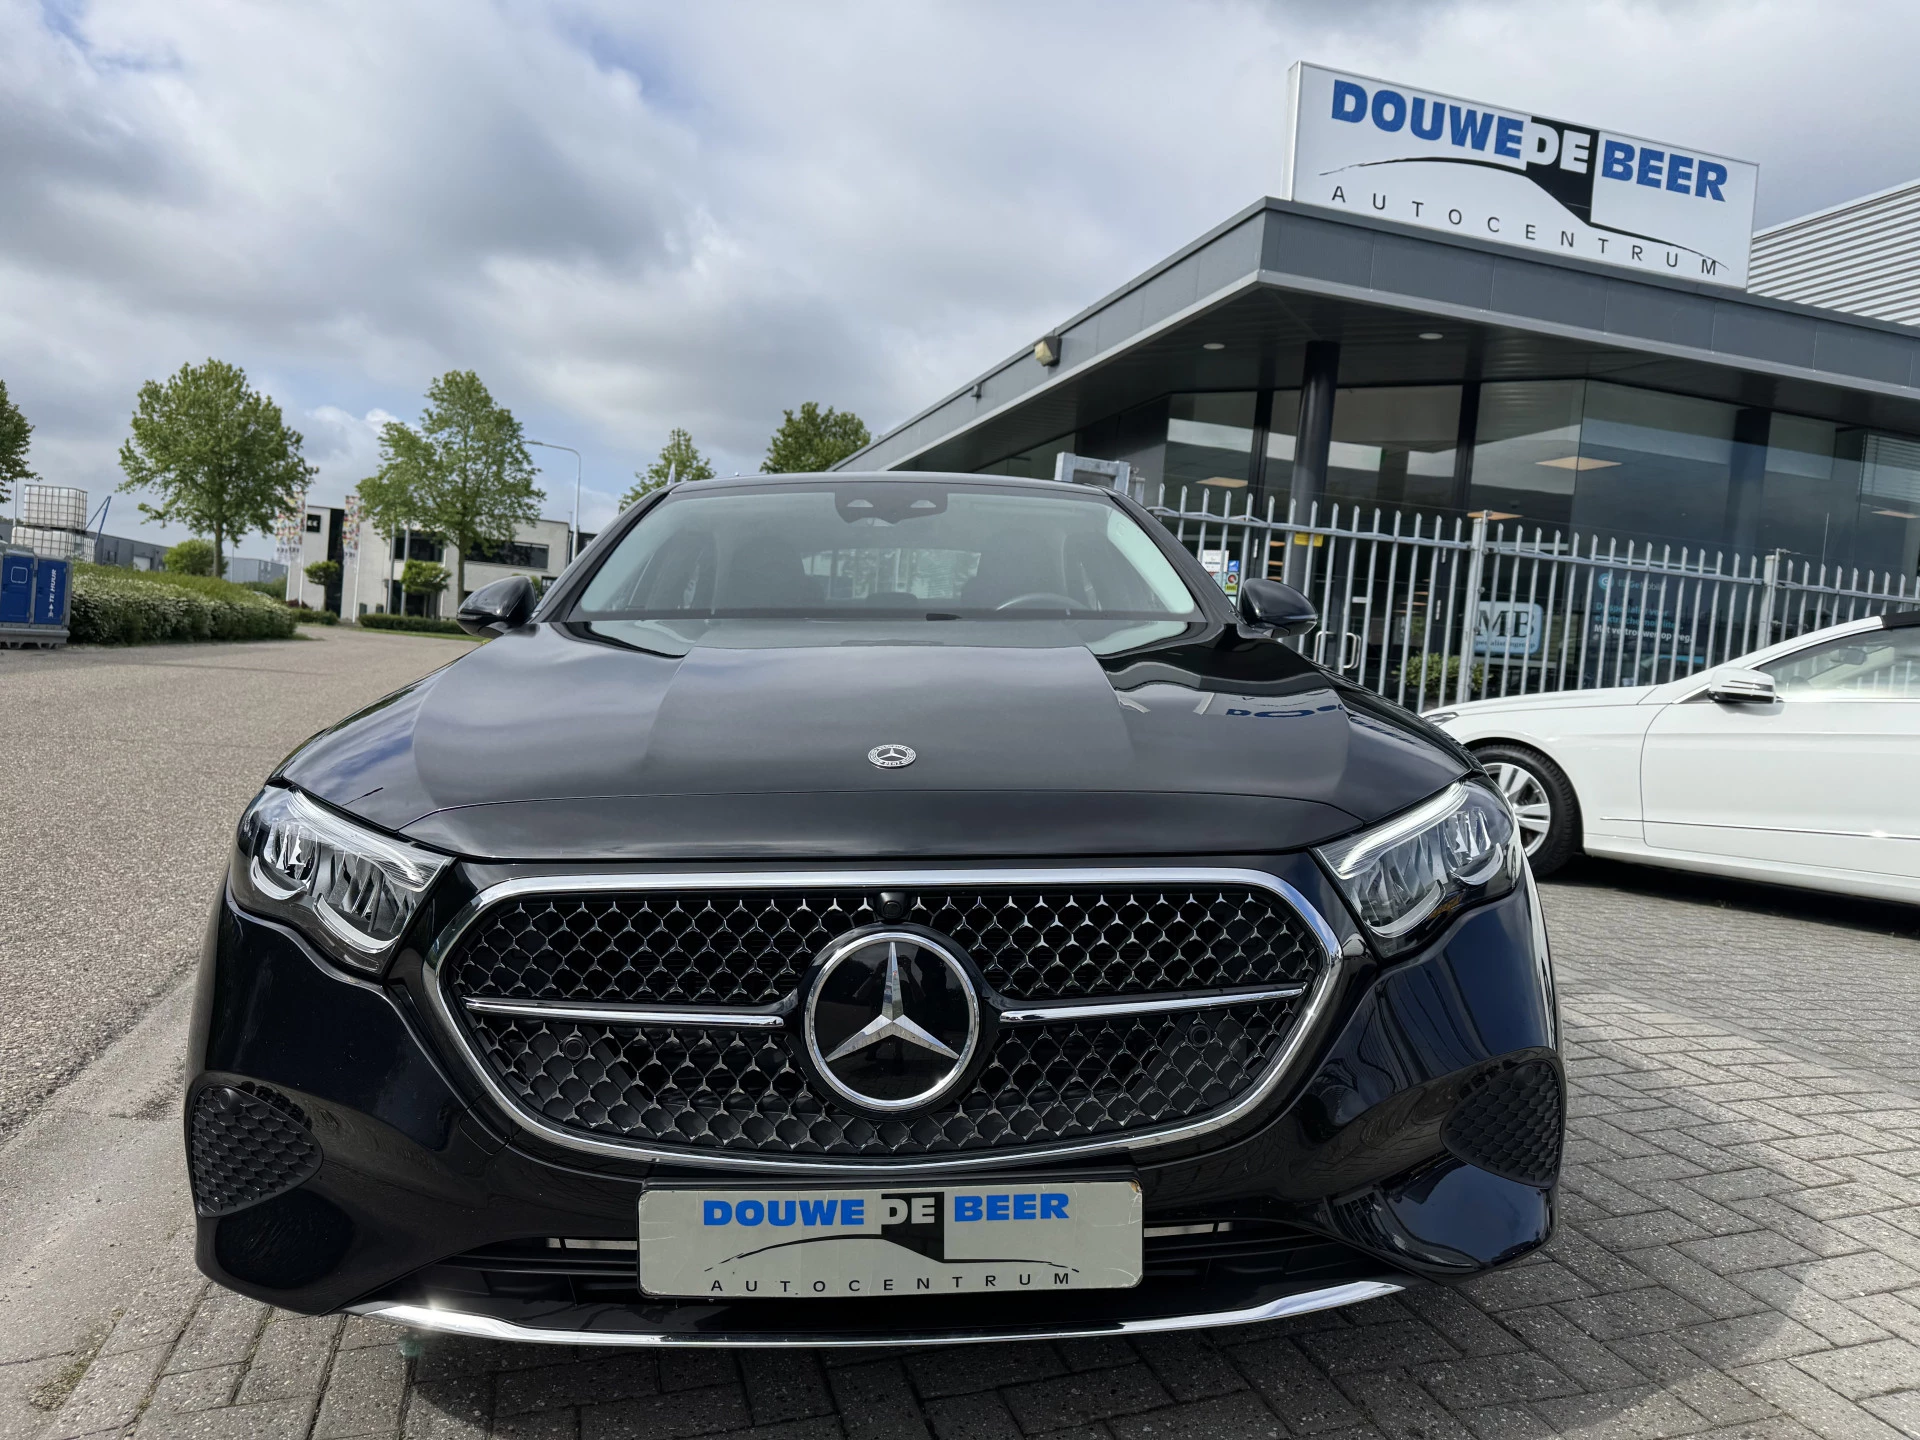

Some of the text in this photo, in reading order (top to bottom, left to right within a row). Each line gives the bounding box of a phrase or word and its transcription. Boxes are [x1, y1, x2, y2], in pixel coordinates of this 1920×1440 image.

[1331, 79, 1728, 202] DOUWE DE BEER
[1331, 185, 1717, 276] AUTOCENTRUM
[1475, 609, 1534, 637] MB
[1649, 608, 1669, 617] vor
[1594, 625, 1610, 634] Mt
[1661, 633, 1672, 641] op
[703, 1192, 1070, 1227] DOUWE DE BEER
[710, 1271, 1070, 1293] AUTOCENTRUM
